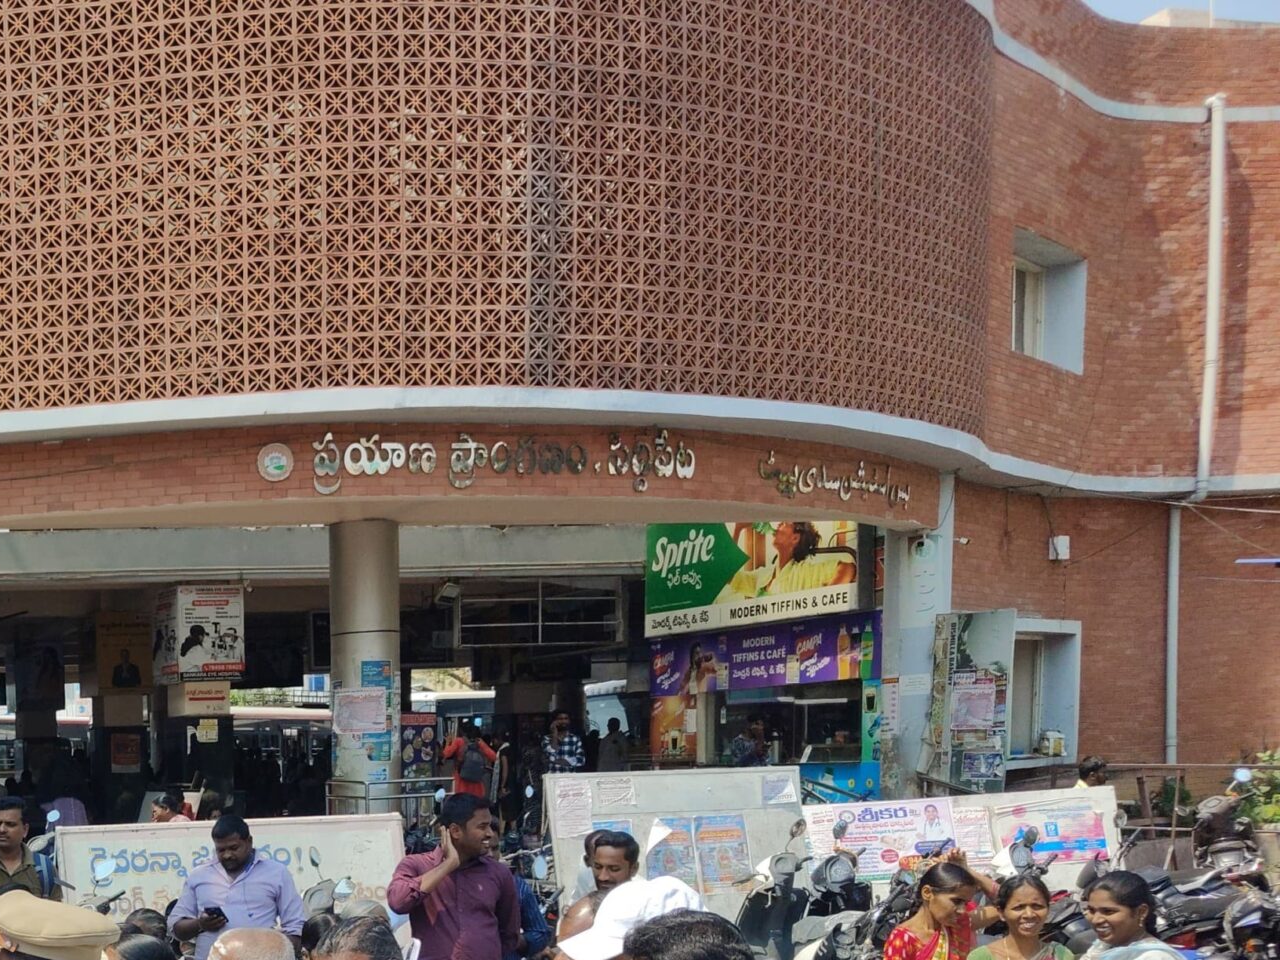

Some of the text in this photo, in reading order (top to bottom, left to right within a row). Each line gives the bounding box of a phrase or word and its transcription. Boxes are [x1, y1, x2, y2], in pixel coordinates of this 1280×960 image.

[312, 432, 437, 494] ప్రయాణ
[651, 528, 715, 578] Sprite
[729, 591, 848, 620] MODERN TIFFINS & CAFE
[742, 635, 775, 648] MODERN
[732, 651, 759, 663] TIFFINS
[759, 650, 765, 660] &
[857, 806, 908, 822] శ్రీకర
